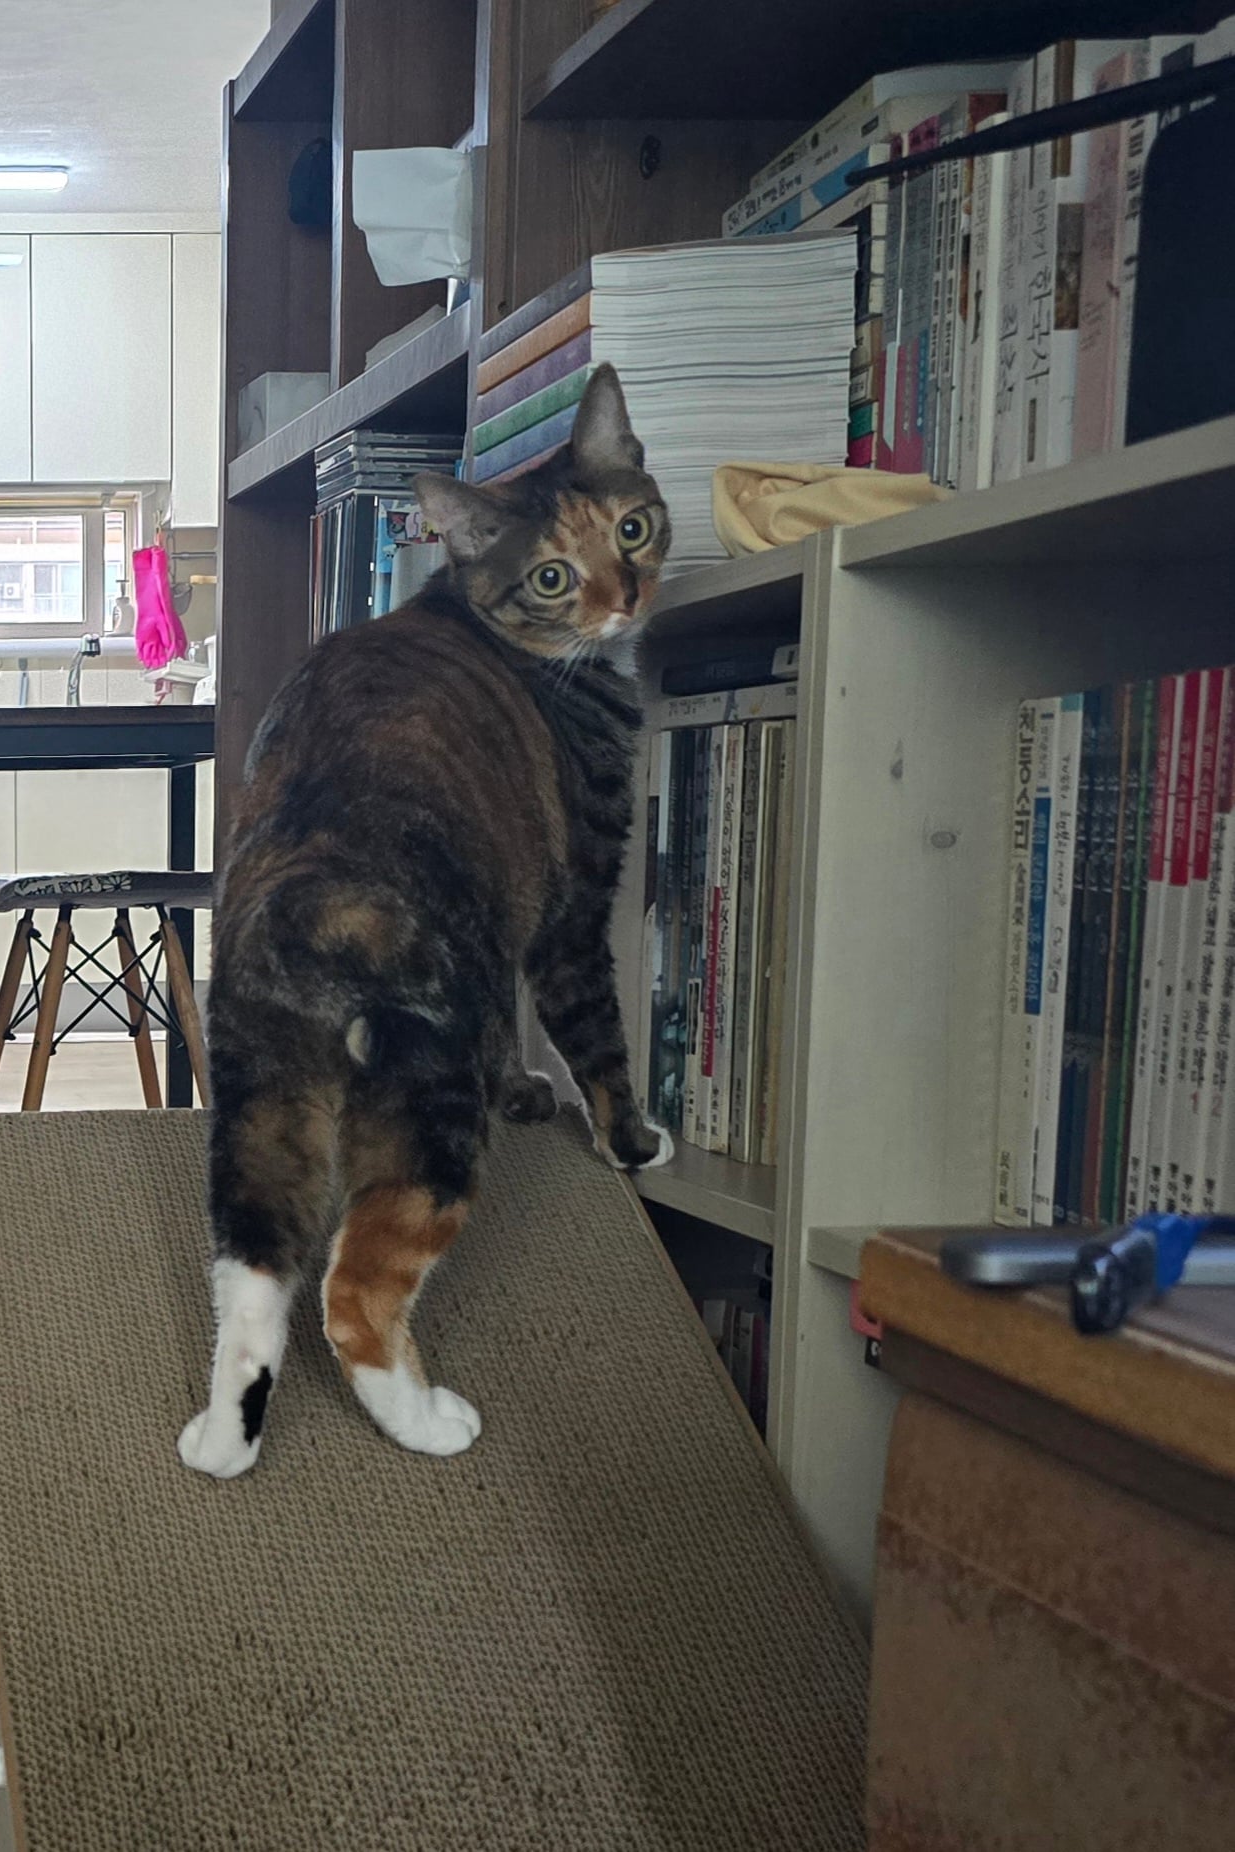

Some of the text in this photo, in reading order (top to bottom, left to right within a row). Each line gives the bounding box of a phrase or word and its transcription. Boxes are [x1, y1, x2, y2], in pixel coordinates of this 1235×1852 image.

[1025, 190, 1053, 385] 이야기 한국사
[1013, 706, 1036, 850] 천둥소리
